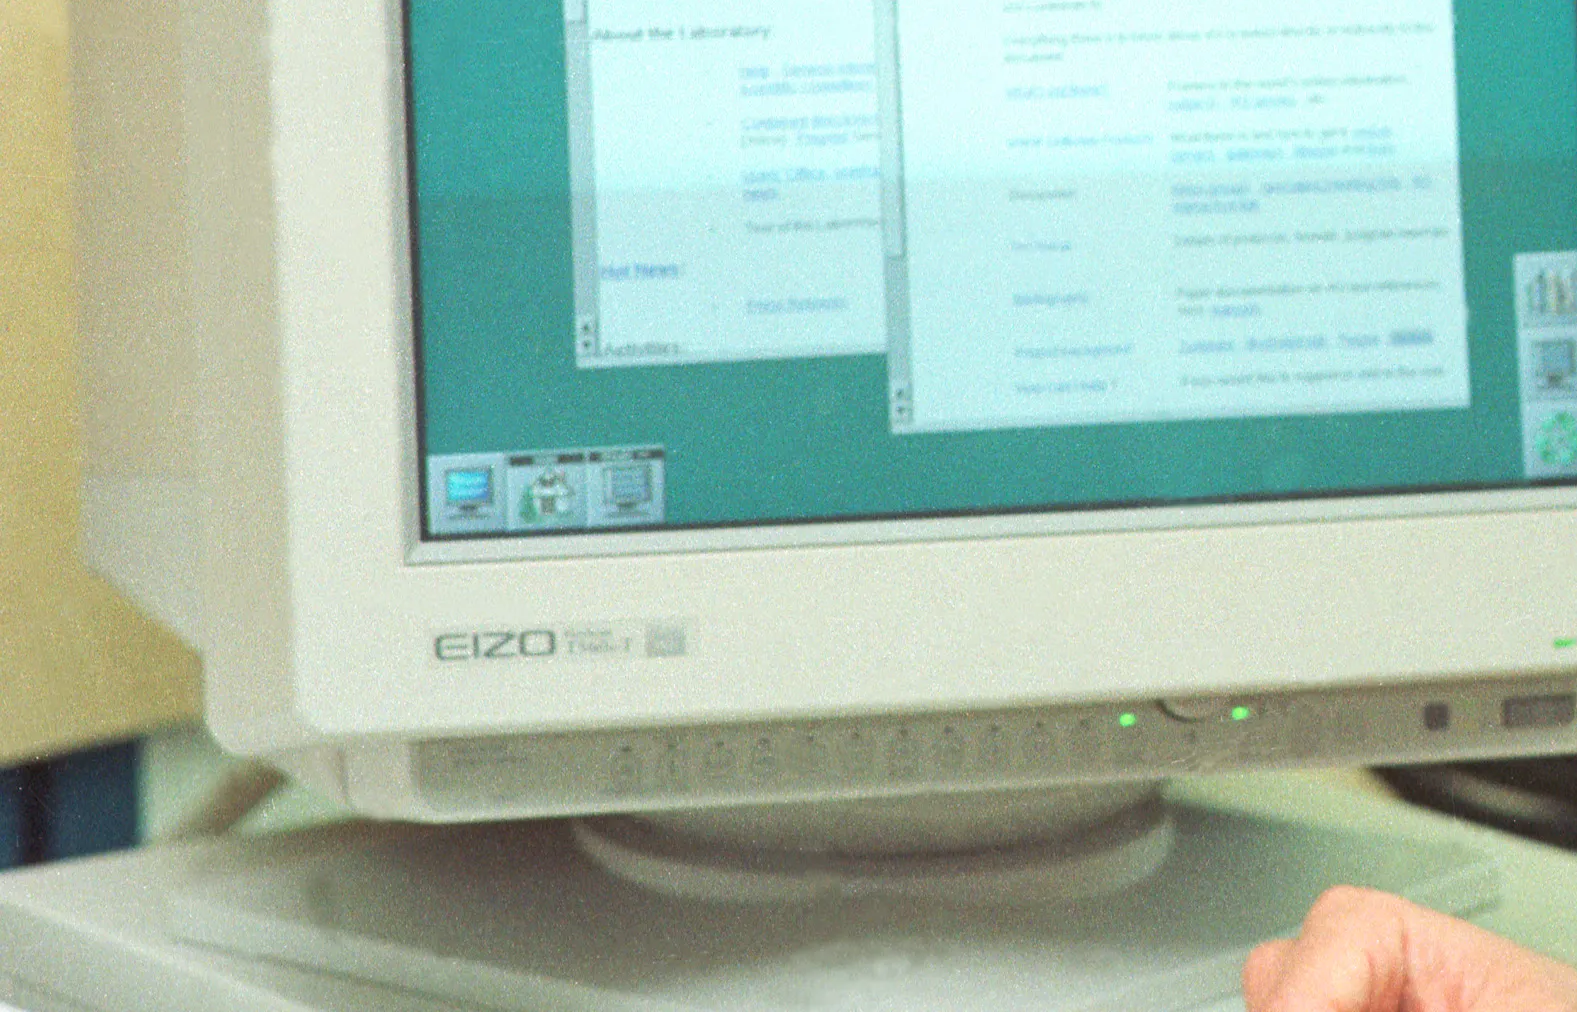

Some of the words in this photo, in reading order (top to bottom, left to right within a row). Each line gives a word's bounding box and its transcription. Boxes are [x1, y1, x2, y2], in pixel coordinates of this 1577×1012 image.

[592, 27, 644, 42] About
[647, 26, 674, 40] the
[679, 24, 771, 42] Laboratory
[434, 629, 556, 662] EIZO
